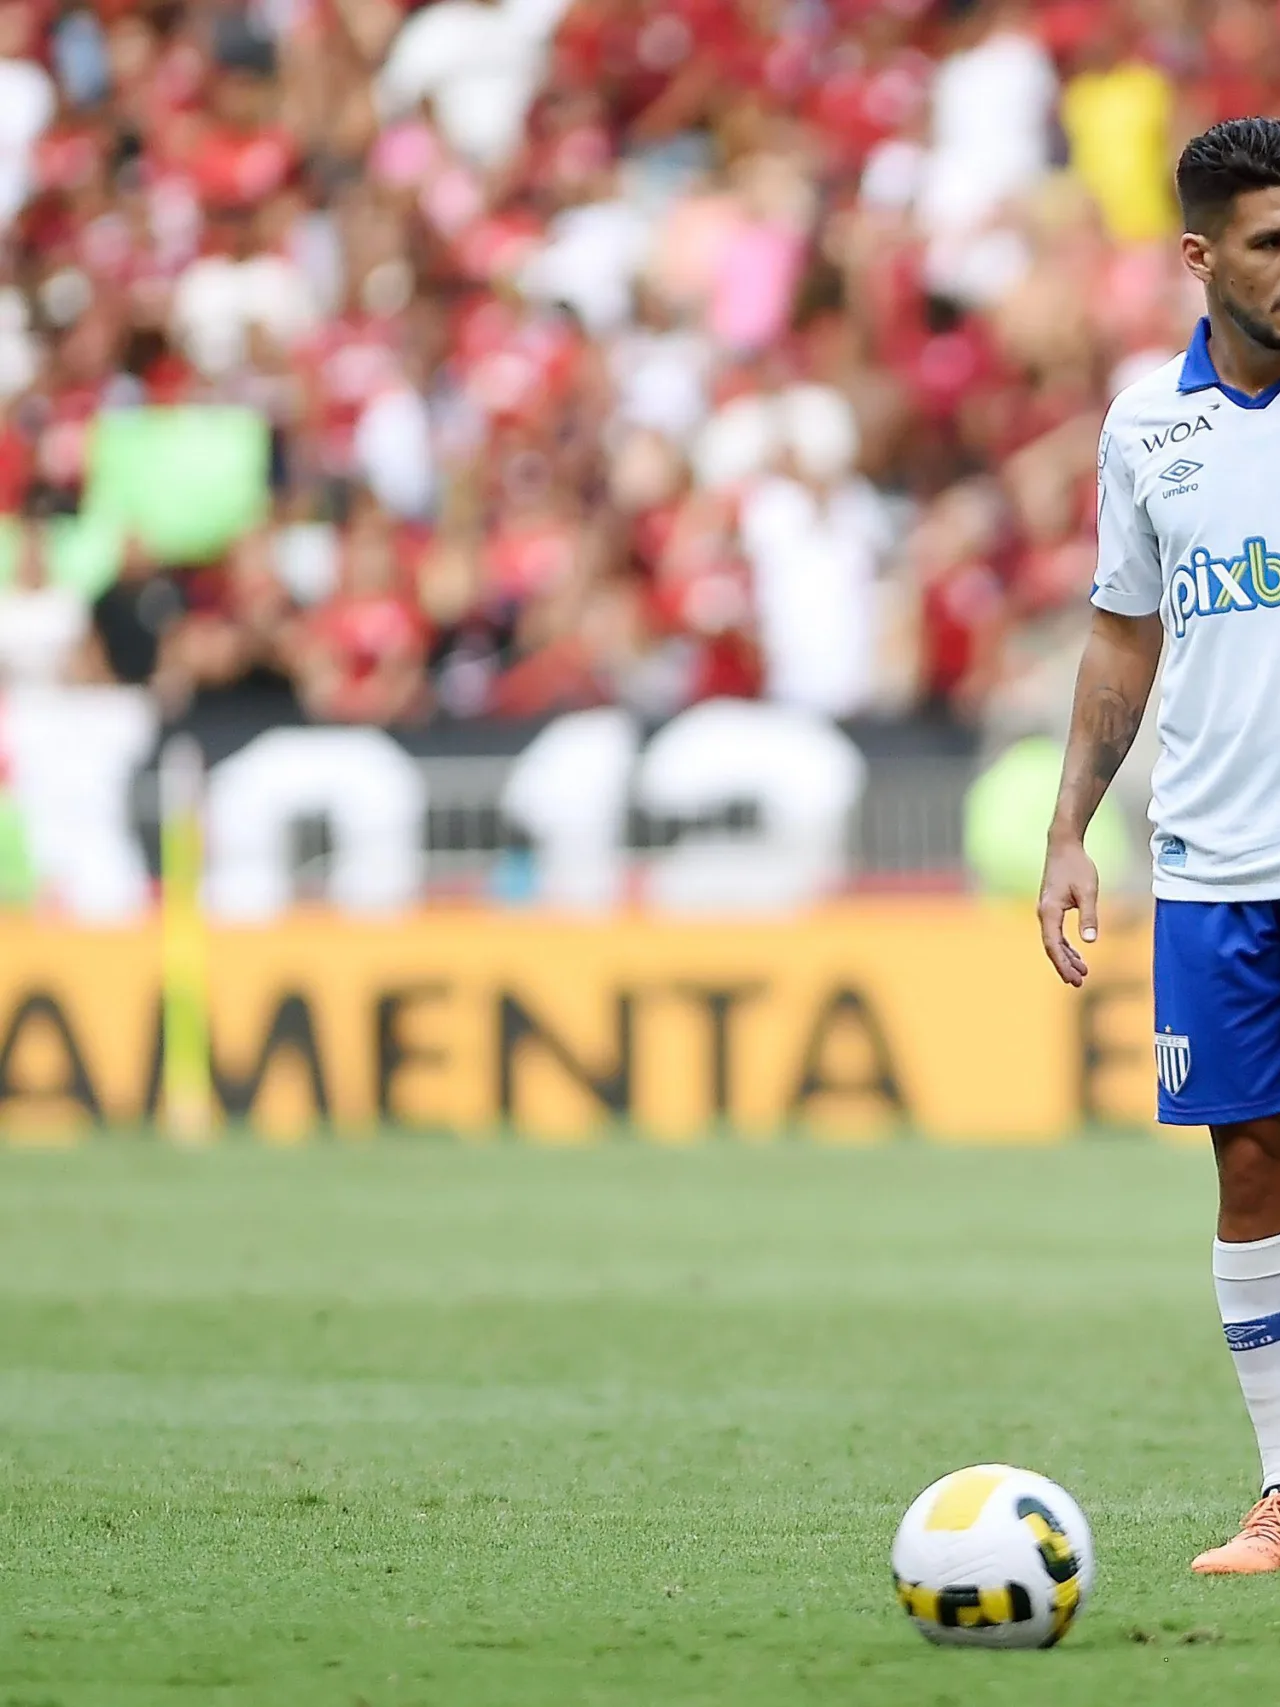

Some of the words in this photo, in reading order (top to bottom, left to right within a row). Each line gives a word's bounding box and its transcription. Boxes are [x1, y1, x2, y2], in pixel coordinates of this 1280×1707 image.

[1140, 415, 1214, 454] WOA
[1162, 483, 1199, 499] umbro
[1230, 1335, 1273, 1349] mbro
